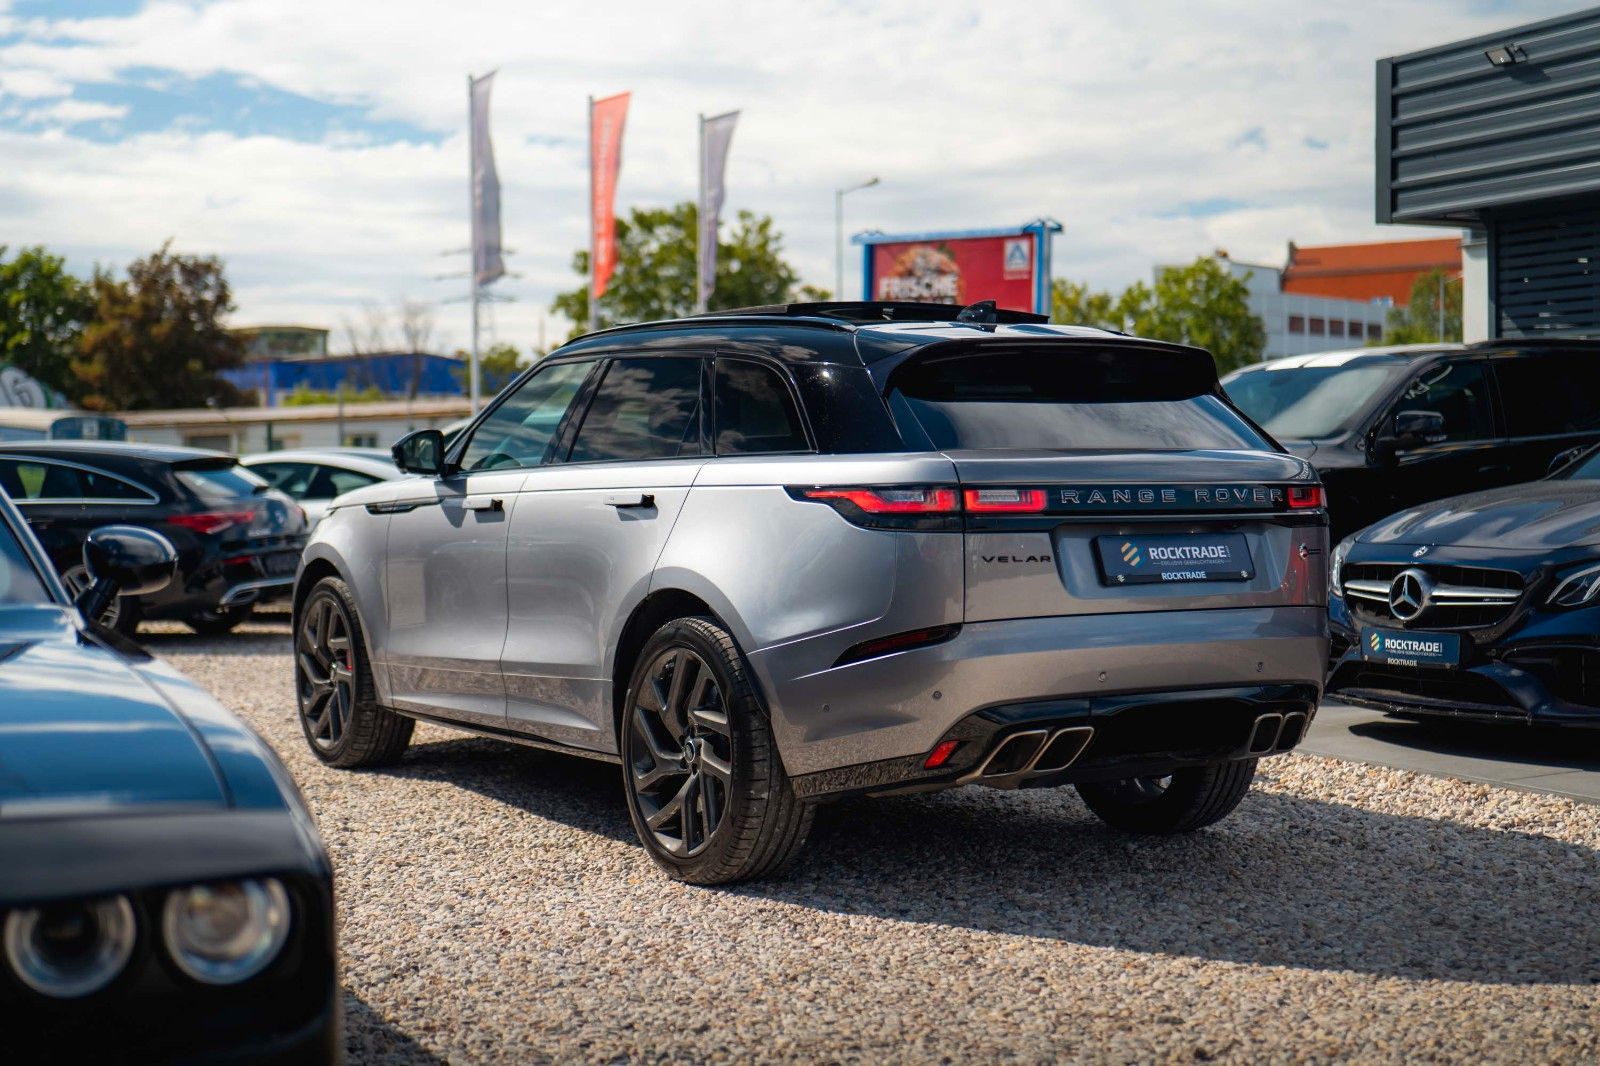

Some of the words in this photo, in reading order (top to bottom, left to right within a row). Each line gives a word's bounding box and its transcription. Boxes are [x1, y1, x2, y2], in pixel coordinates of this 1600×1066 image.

[1060, 489, 1176, 503] RANGE
[1195, 488, 1283, 502] ROVER
[1149, 546, 1227, 559] ROCKTRADE
[982, 555, 1051, 563] VELAR
[1161, 571, 1206, 580] ROCKTRADE
[1385, 638, 1439, 652] ROCKTRADE
[1387, 657, 1418, 666] ROCKTRADE
